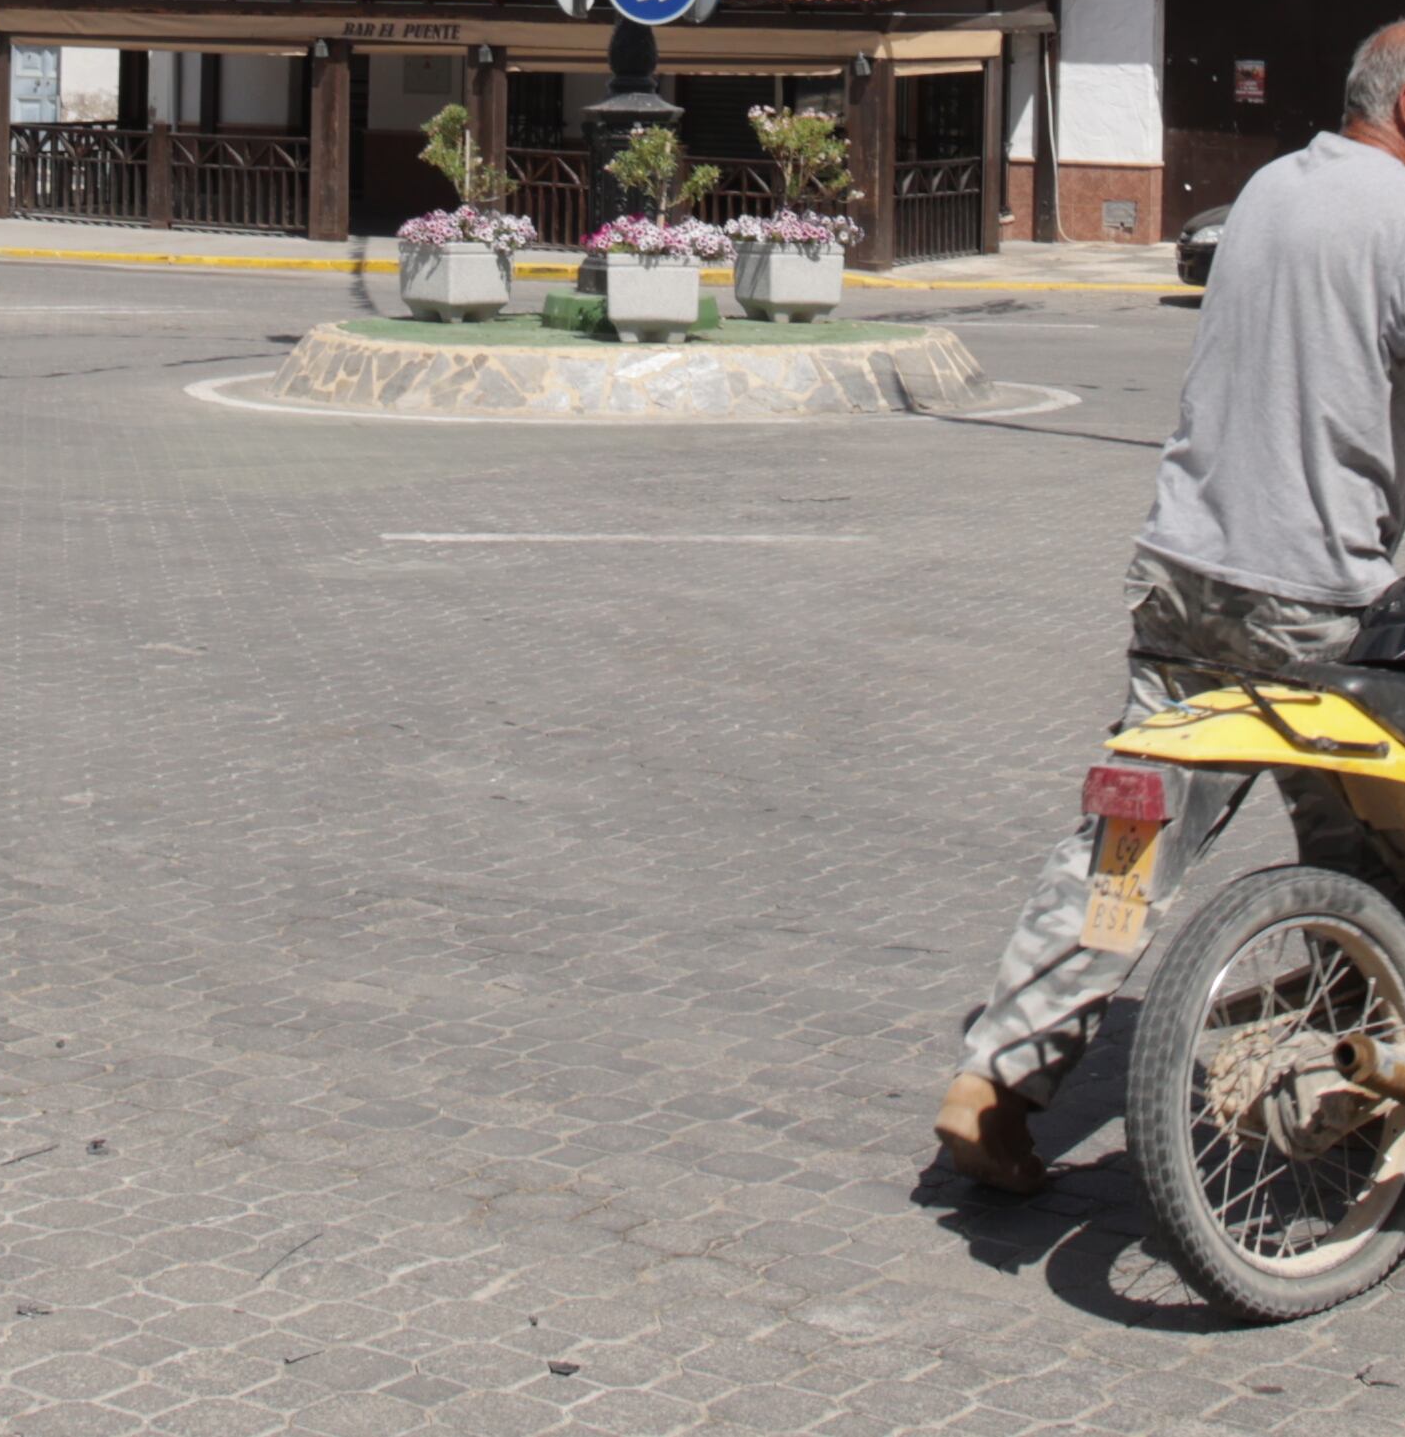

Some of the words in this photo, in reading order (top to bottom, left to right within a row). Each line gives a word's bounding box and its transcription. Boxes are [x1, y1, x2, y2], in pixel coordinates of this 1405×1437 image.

[342, 22, 375, 36] BAR
[378, 23, 395, 37] EL
[402, 24, 461, 40] PUENTE
